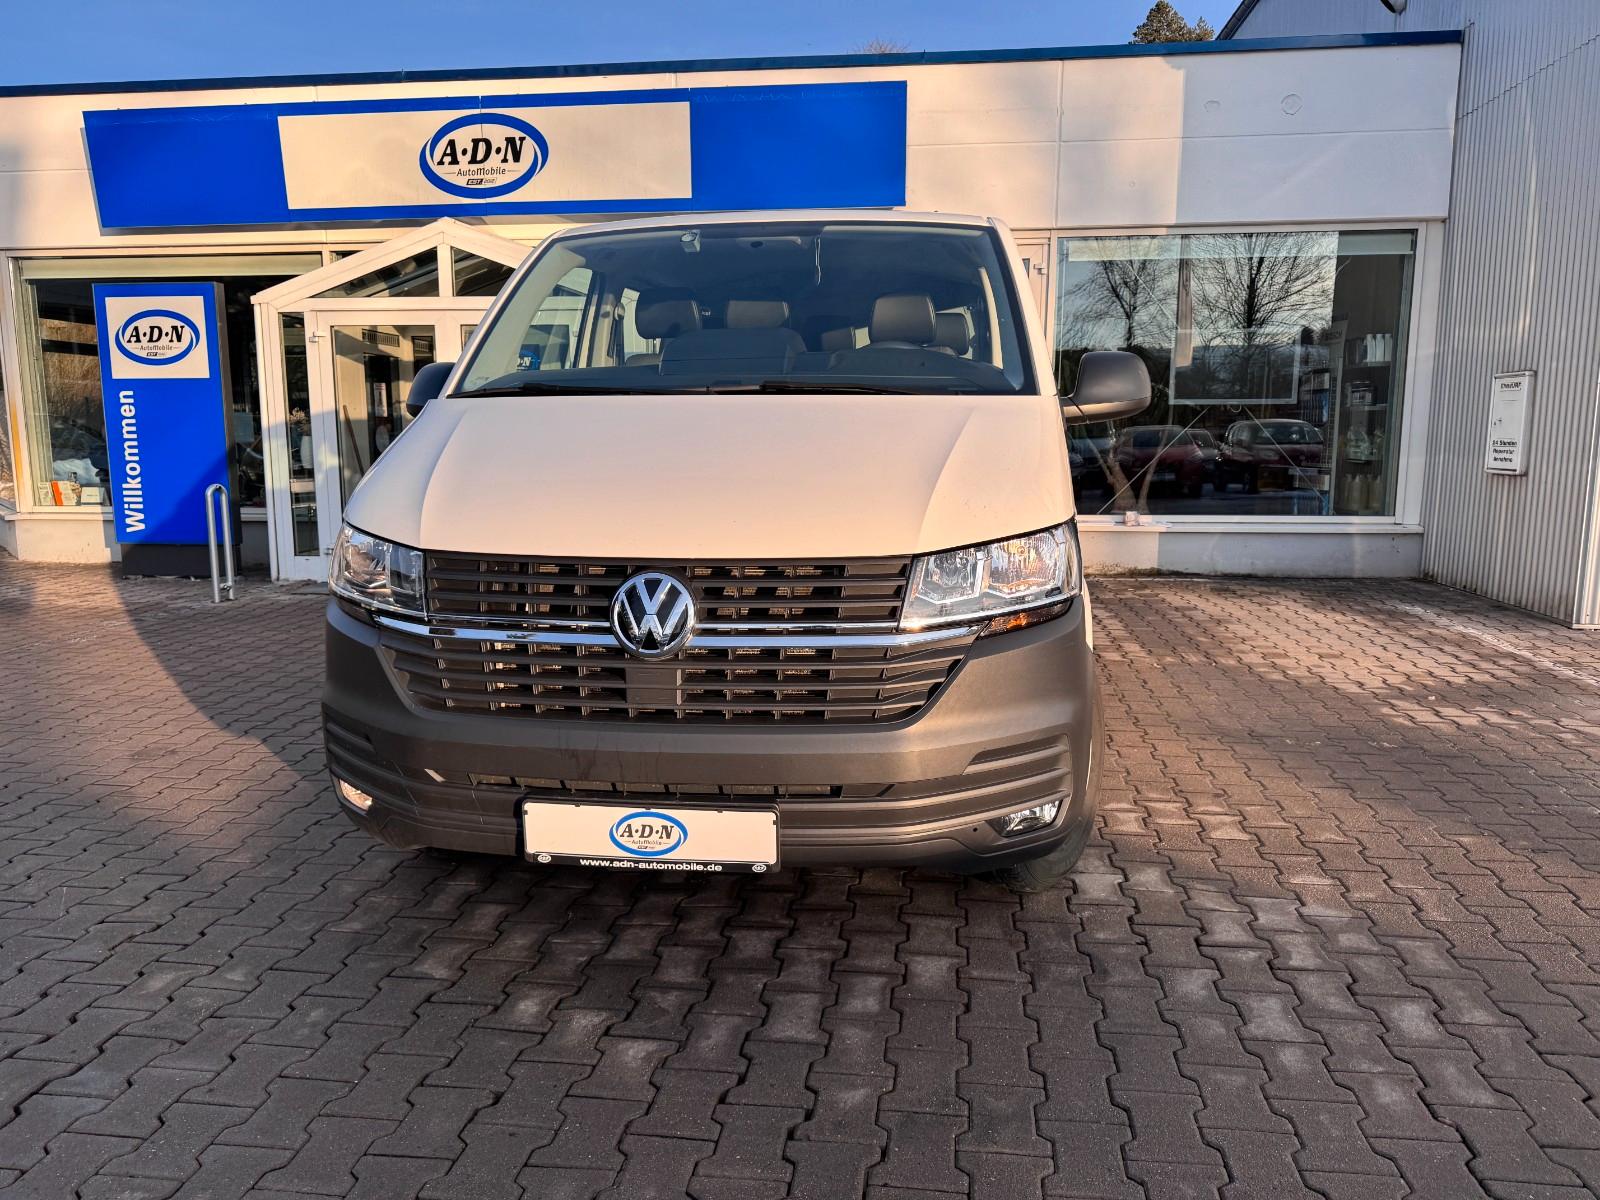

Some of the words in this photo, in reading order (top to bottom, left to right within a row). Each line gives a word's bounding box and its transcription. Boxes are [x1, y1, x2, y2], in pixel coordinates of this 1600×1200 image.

[457, 166, 506, 177] AutoMobile
[119, 390, 146, 533] Willkommen
[579, 858, 723, 873] www.adn-automobile.de
